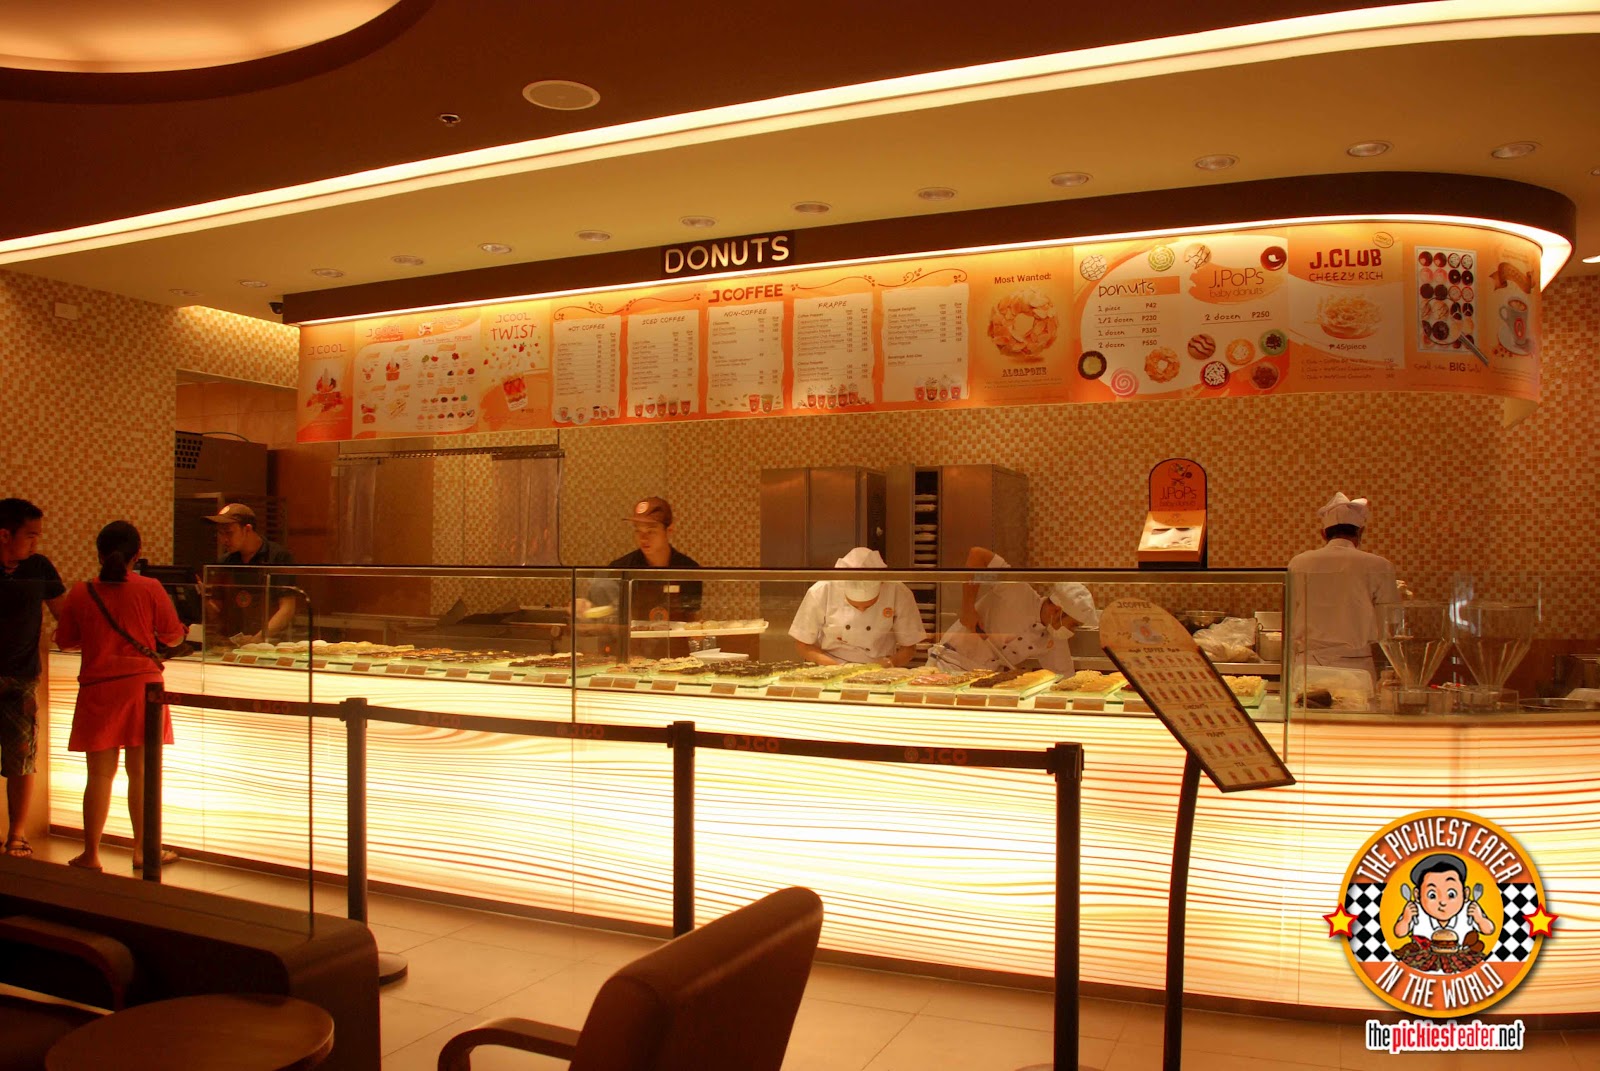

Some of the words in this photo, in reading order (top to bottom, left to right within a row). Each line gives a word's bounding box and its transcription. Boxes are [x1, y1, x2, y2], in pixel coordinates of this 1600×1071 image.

[665, 235, 789, 274] DONUTS
[1309, 248, 1382, 270] J.CLUB
[993, 275, 1015, 285] Most
[1016, 272, 1052, 283] Wanted:
[1309, 272, 1355, 282] CHEEZY
[1358, 271, 1384, 281] RICH
[1098, 278, 1155, 298] Donuts
[1209, 289, 1231, 298] baby
[1233, 287, 1264, 297] donuts
[723, 308, 768, 318] NON-COFFEE
[1104, 305, 1121, 313] piece
[660, 315, 686, 324] COFFEE
[1204, 313, 1211, 321] 2
[1214, 312, 1241, 321] dozen
[490, 324, 537, 341] TWIST
[1449, 362, 1467, 372] BIG
